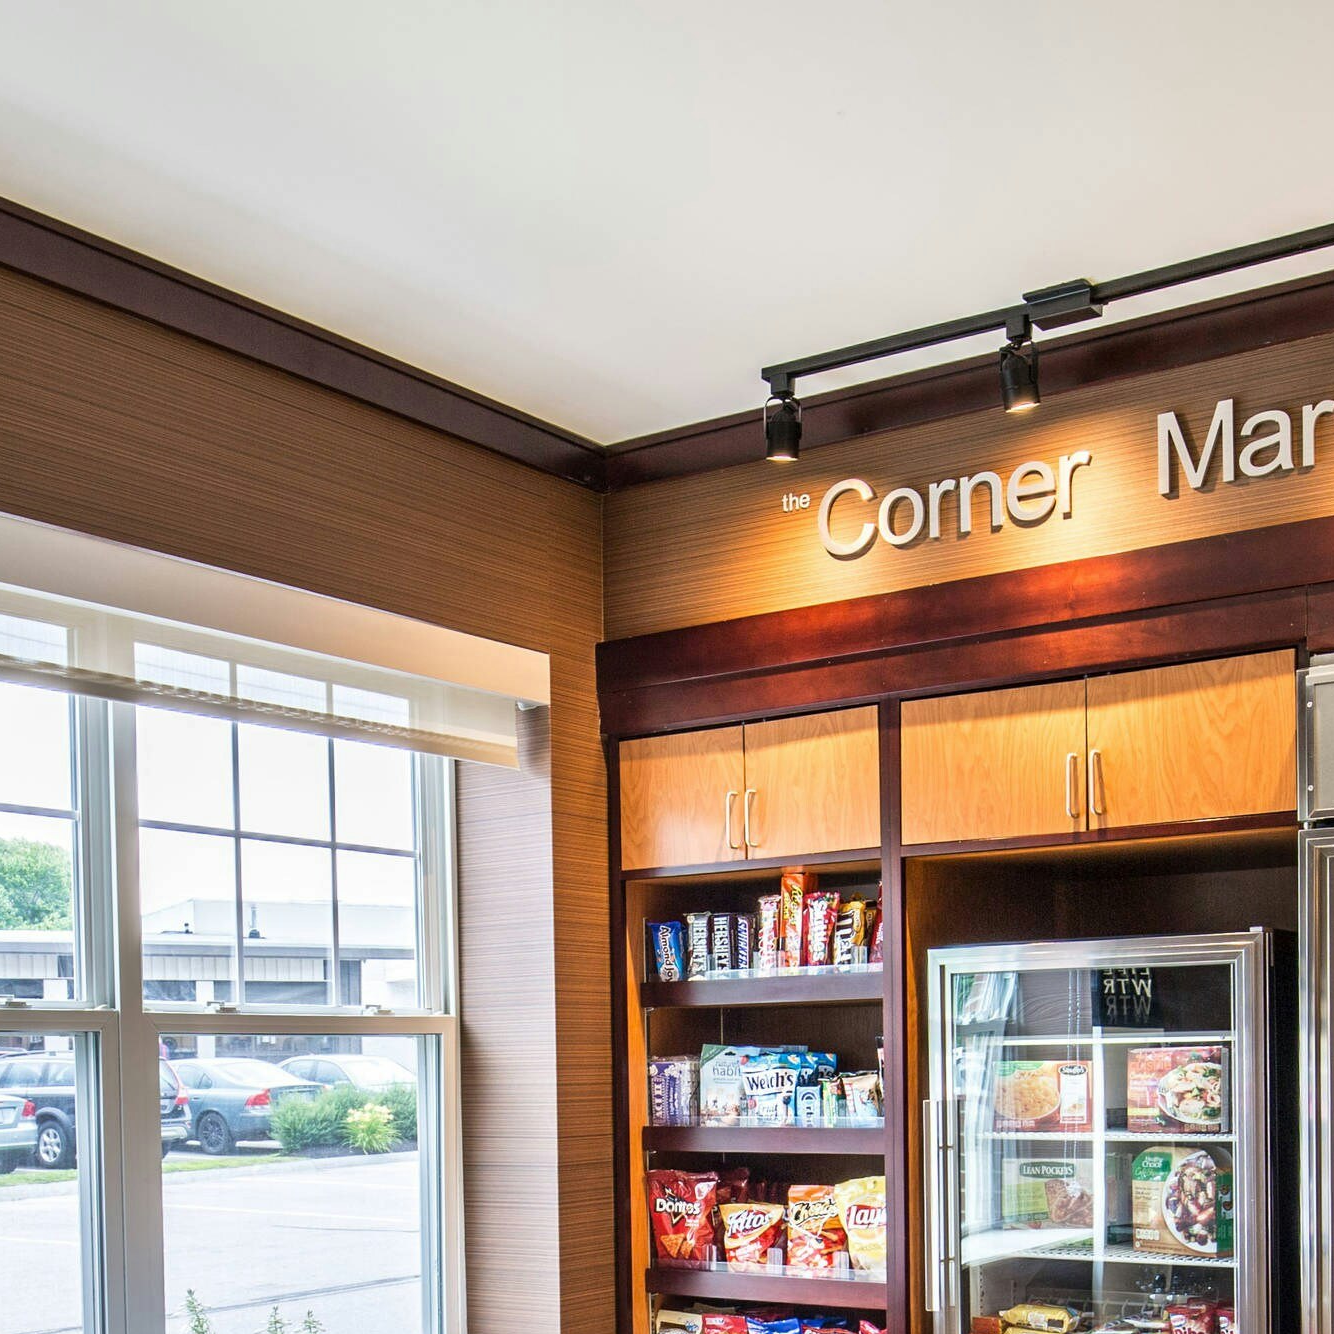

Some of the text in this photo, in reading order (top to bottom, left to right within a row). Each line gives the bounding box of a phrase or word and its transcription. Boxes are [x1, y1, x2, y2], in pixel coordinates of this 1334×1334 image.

[781, 489, 810, 514] the
[817, 447, 1093, 557] Corner
[659, 925, 673, 966] Almond
[746, 1071, 794, 1091] Welch's
[655, 1197, 701, 1215] Doritos
